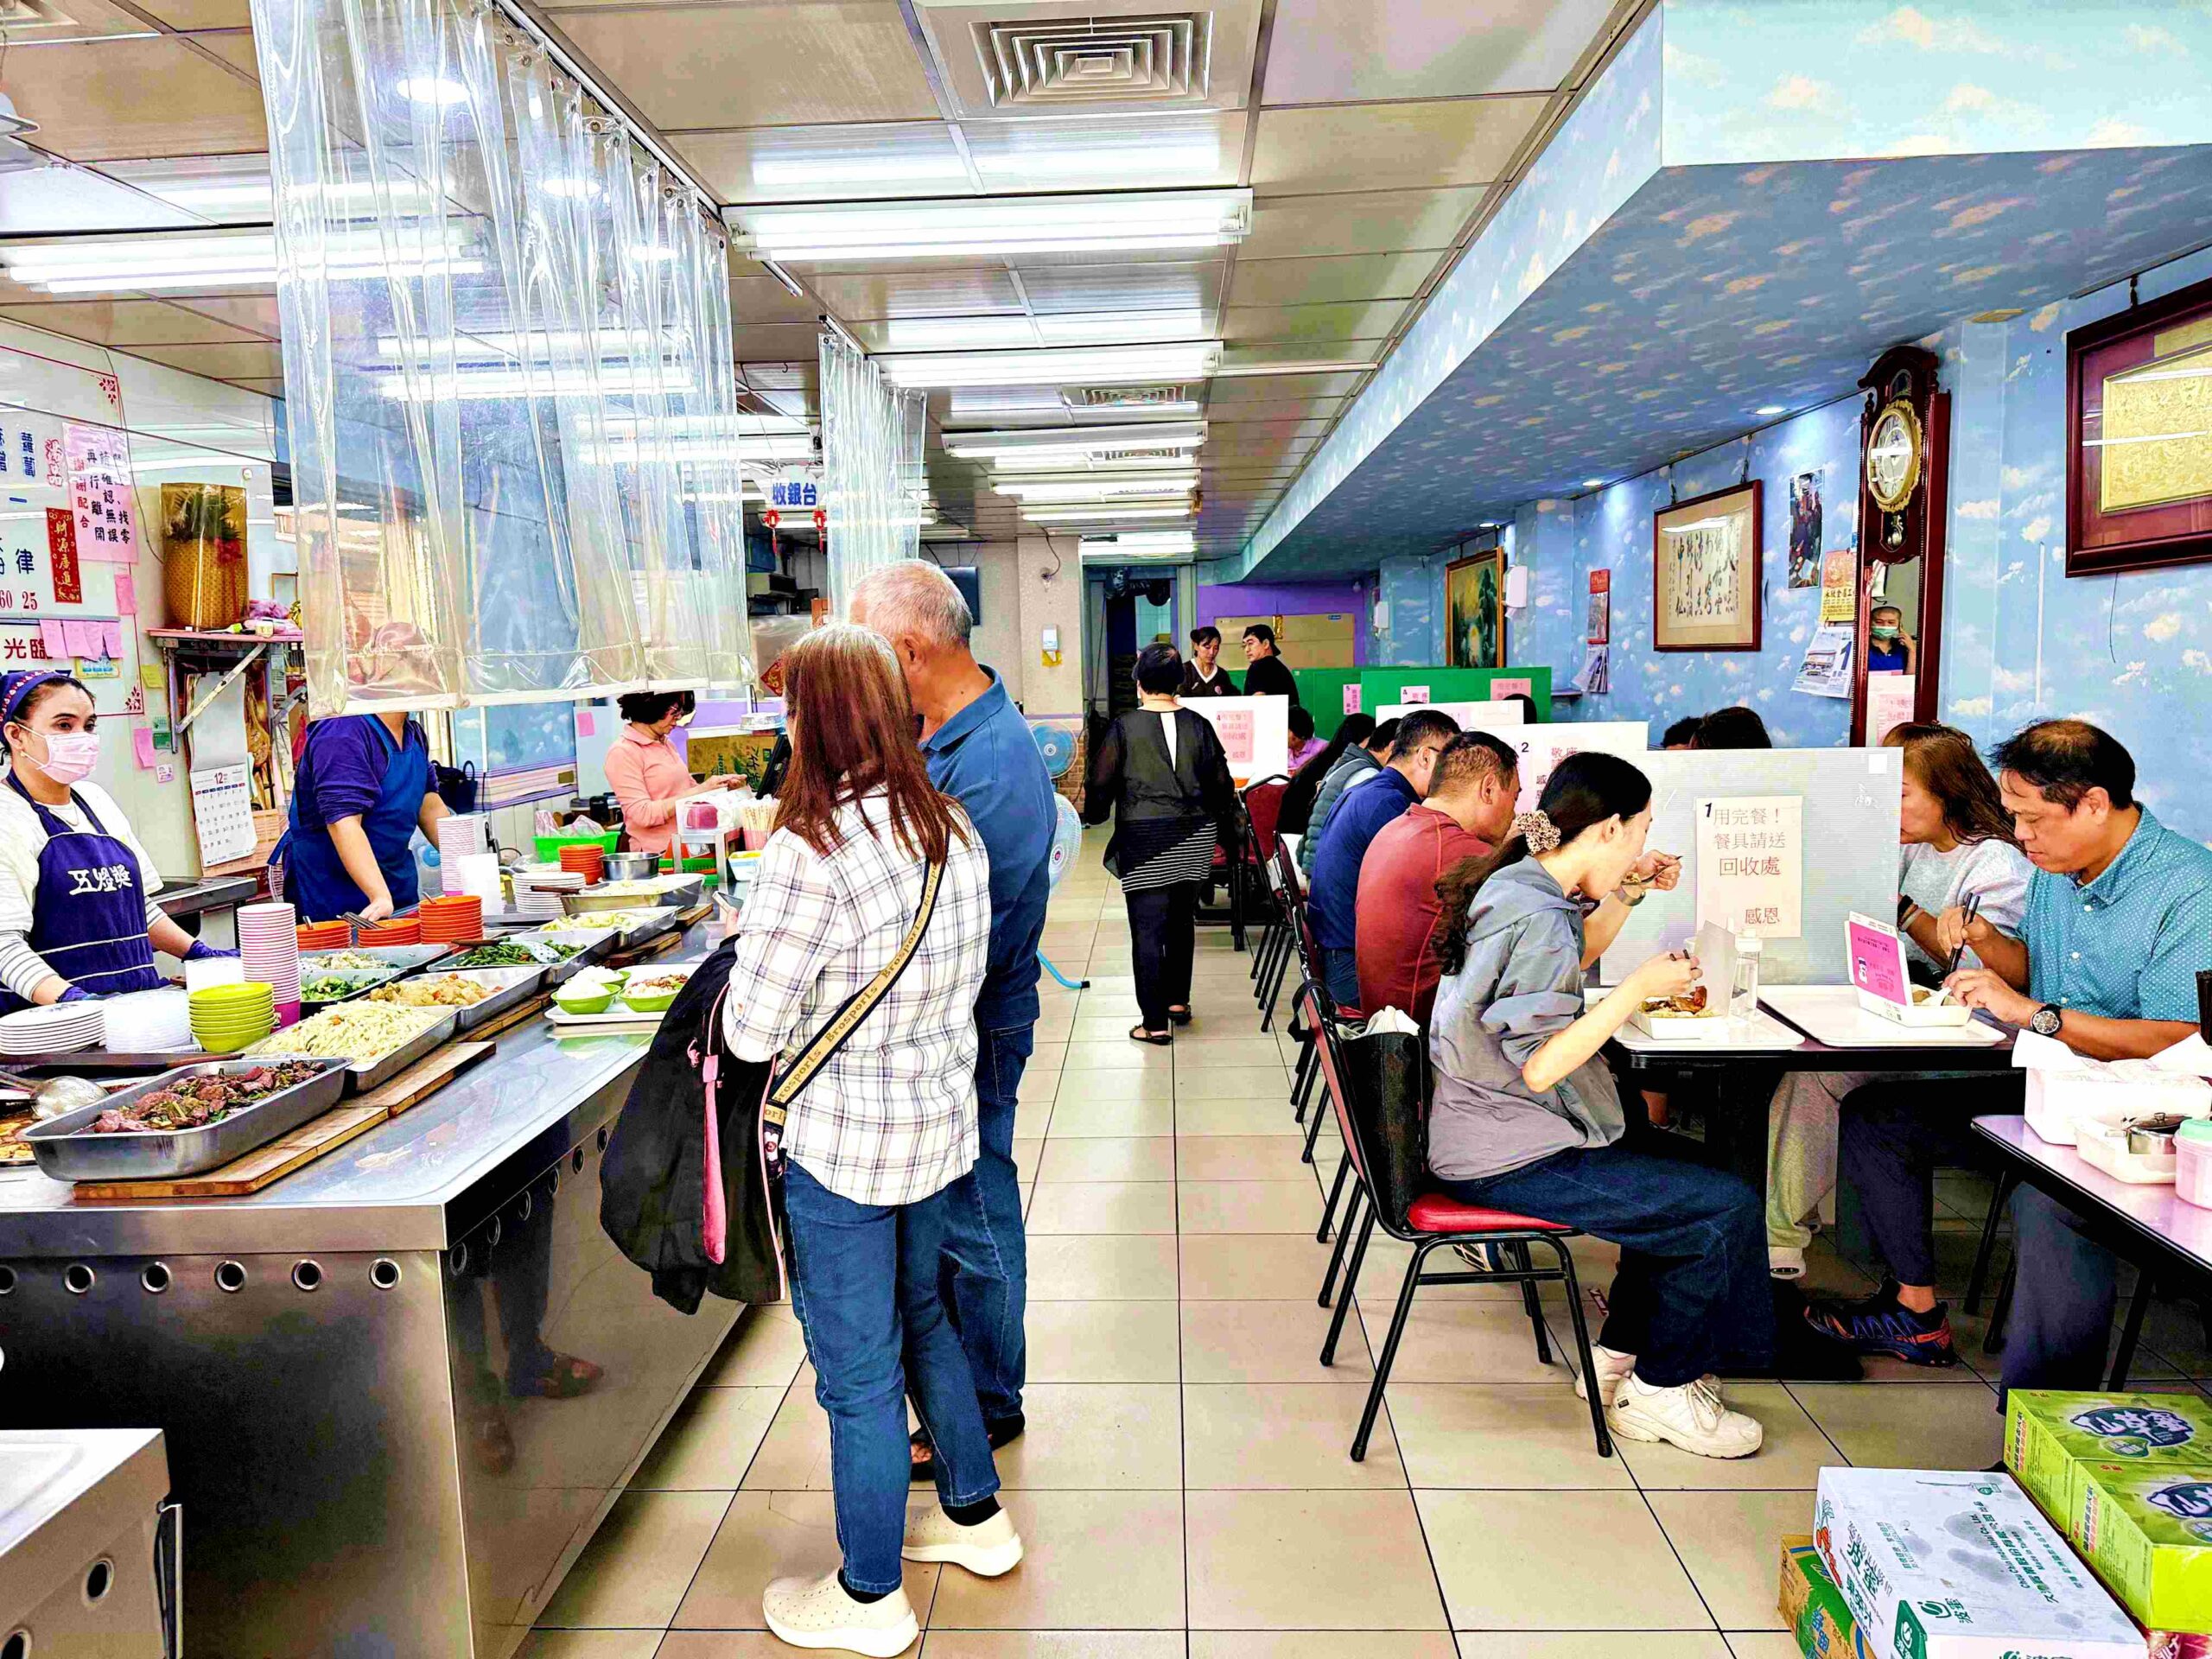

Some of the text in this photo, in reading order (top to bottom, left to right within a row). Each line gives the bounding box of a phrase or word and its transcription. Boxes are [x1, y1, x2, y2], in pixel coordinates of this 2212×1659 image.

[86, 448, 105, 542] 再行離開
[772, 482, 817, 505] 收銀台
[22, 590, 37, 610] 25
[1522, 742, 1529, 753] 2
[213, 772, 224, 785] 12
[1704, 802, 1713, 817] 1
[1713, 808, 1779, 826] 用完餐！
[1713, 831, 1786, 850] 餐具請送
[1719, 855, 1782, 877] 回收處
[67, 864, 133, 895] 五燈獎
[1745, 906, 1780, 925] 感恩
